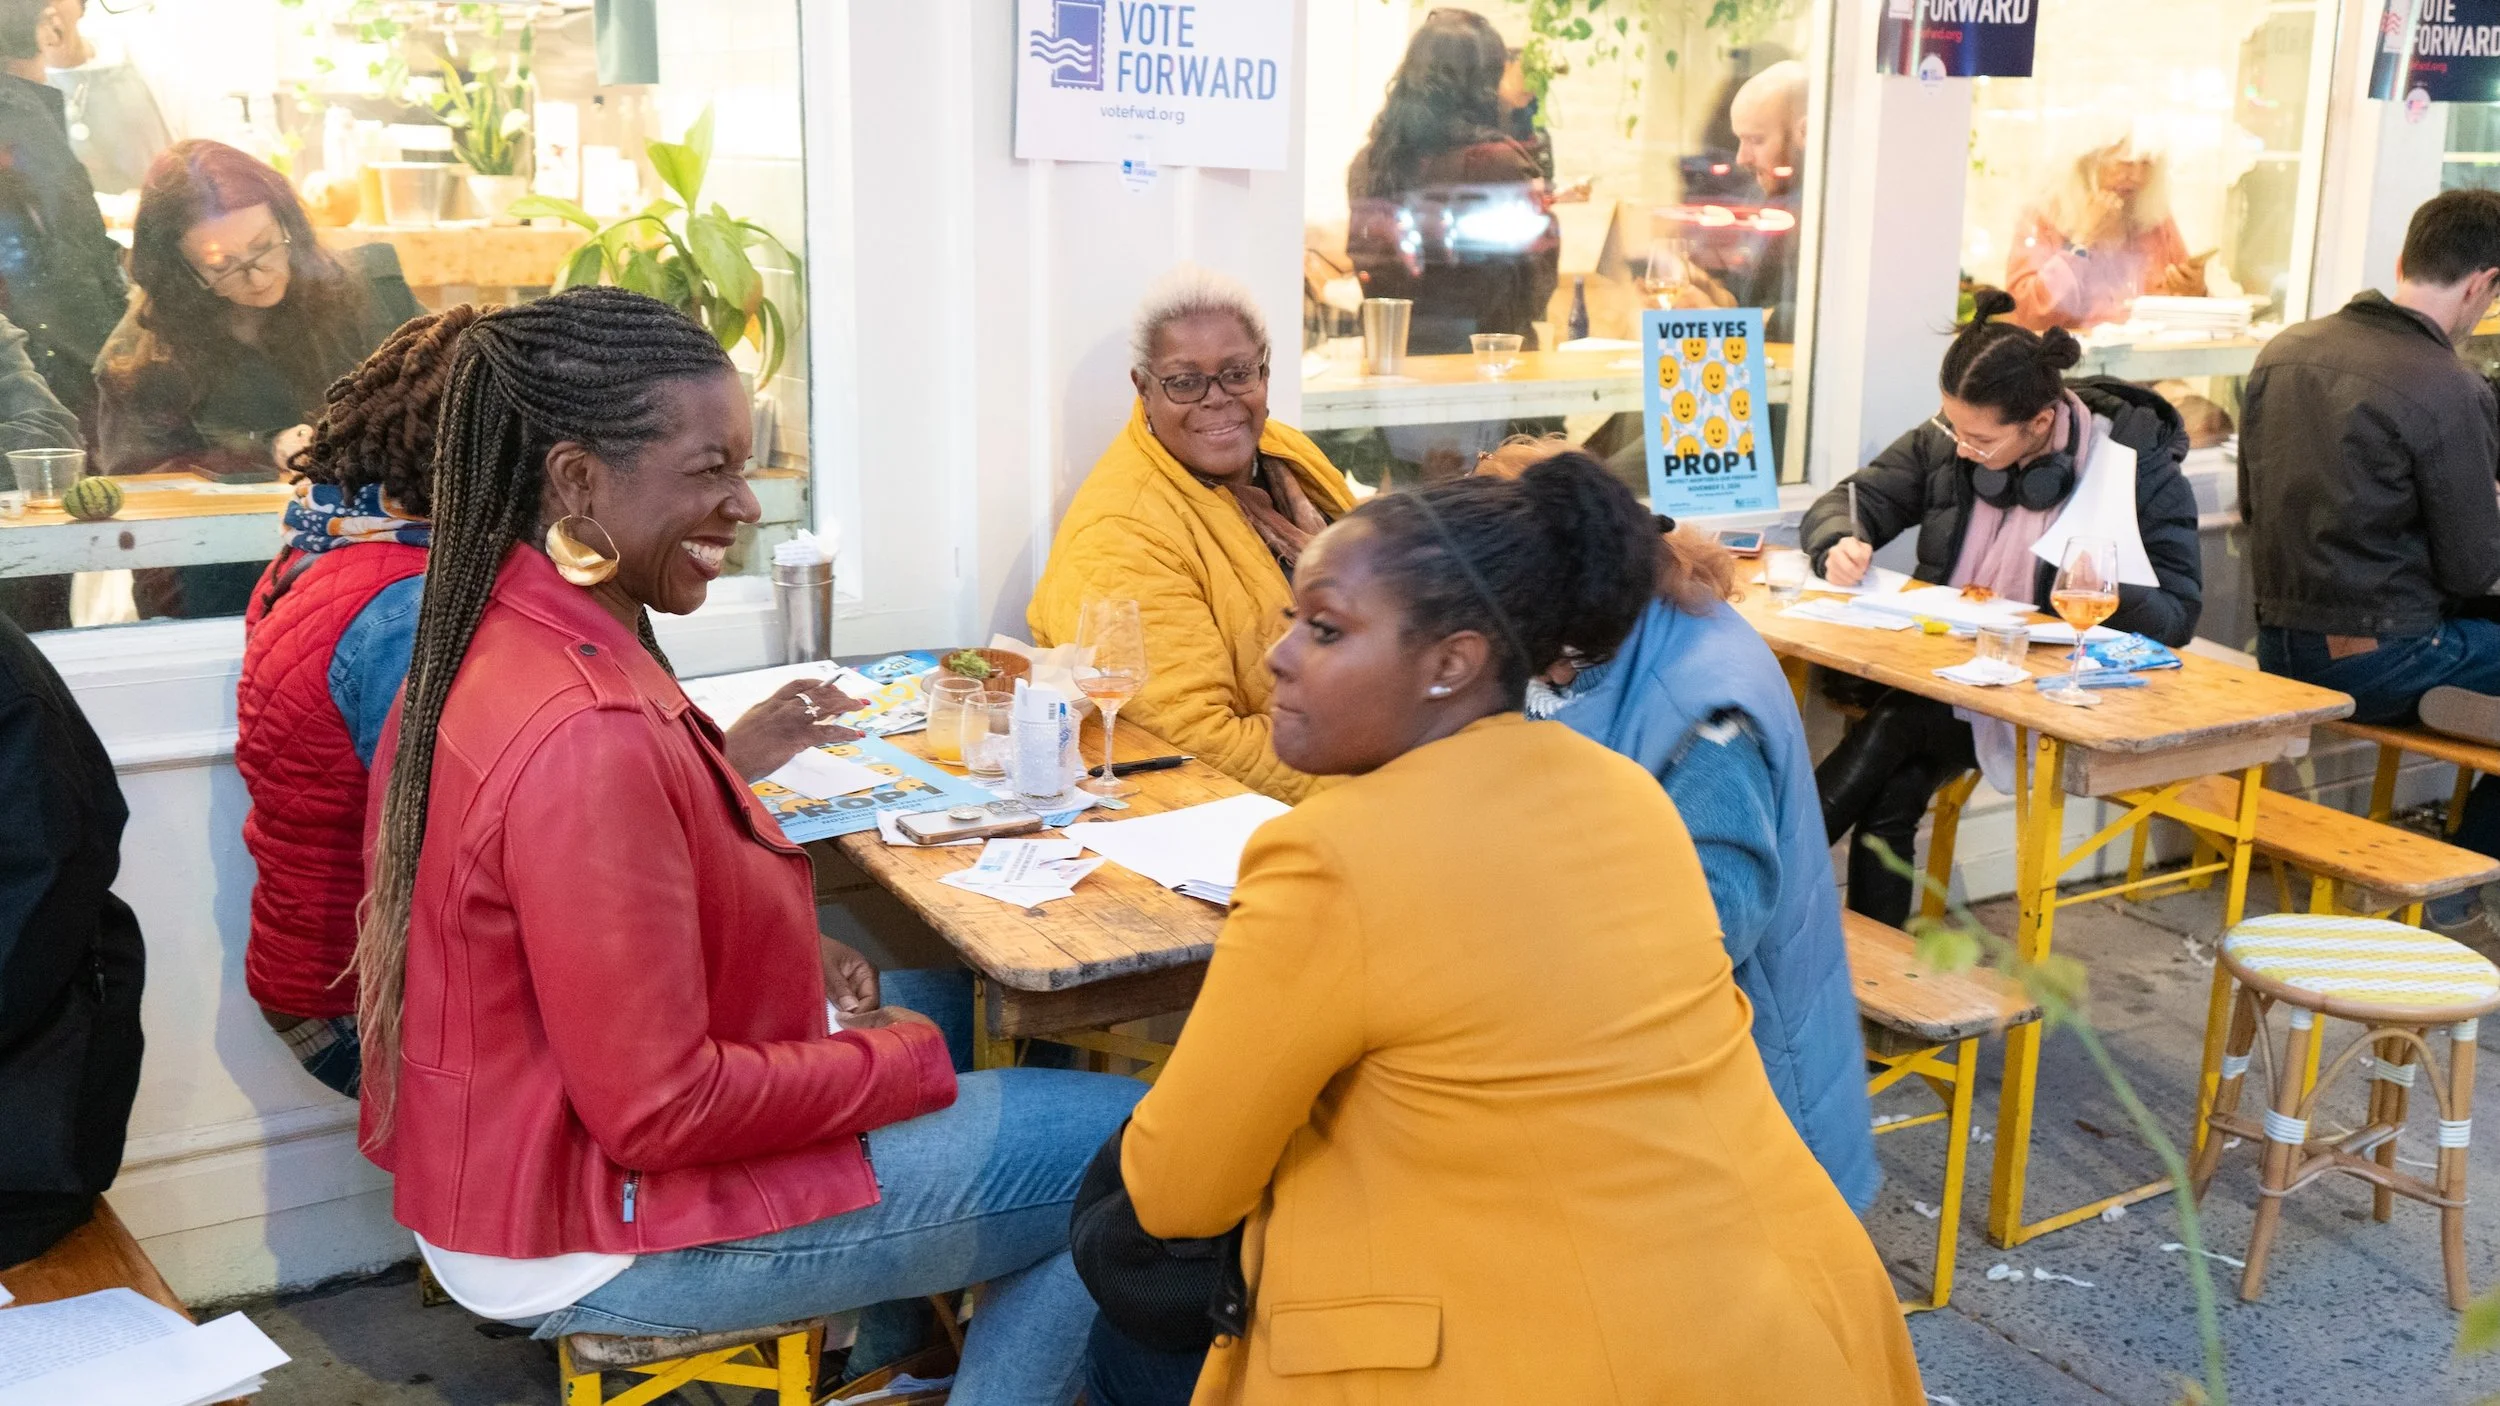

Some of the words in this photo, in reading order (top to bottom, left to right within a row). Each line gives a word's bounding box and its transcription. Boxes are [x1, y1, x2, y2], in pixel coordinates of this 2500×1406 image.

[1119, 1, 1195, 48] VOTE
[1117, 50, 1277, 100] FORWARD
[1100, 104, 1185, 124] votefwd.org
[1658, 322, 1708, 339] VOTE
[1712, 321, 1747, 338] YES
[1664, 452, 1740, 477] PROP
[1745, 451, 1757, 471] 1
[773, 791, 908, 825] PROP
[915, 783, 944, 796] 1
